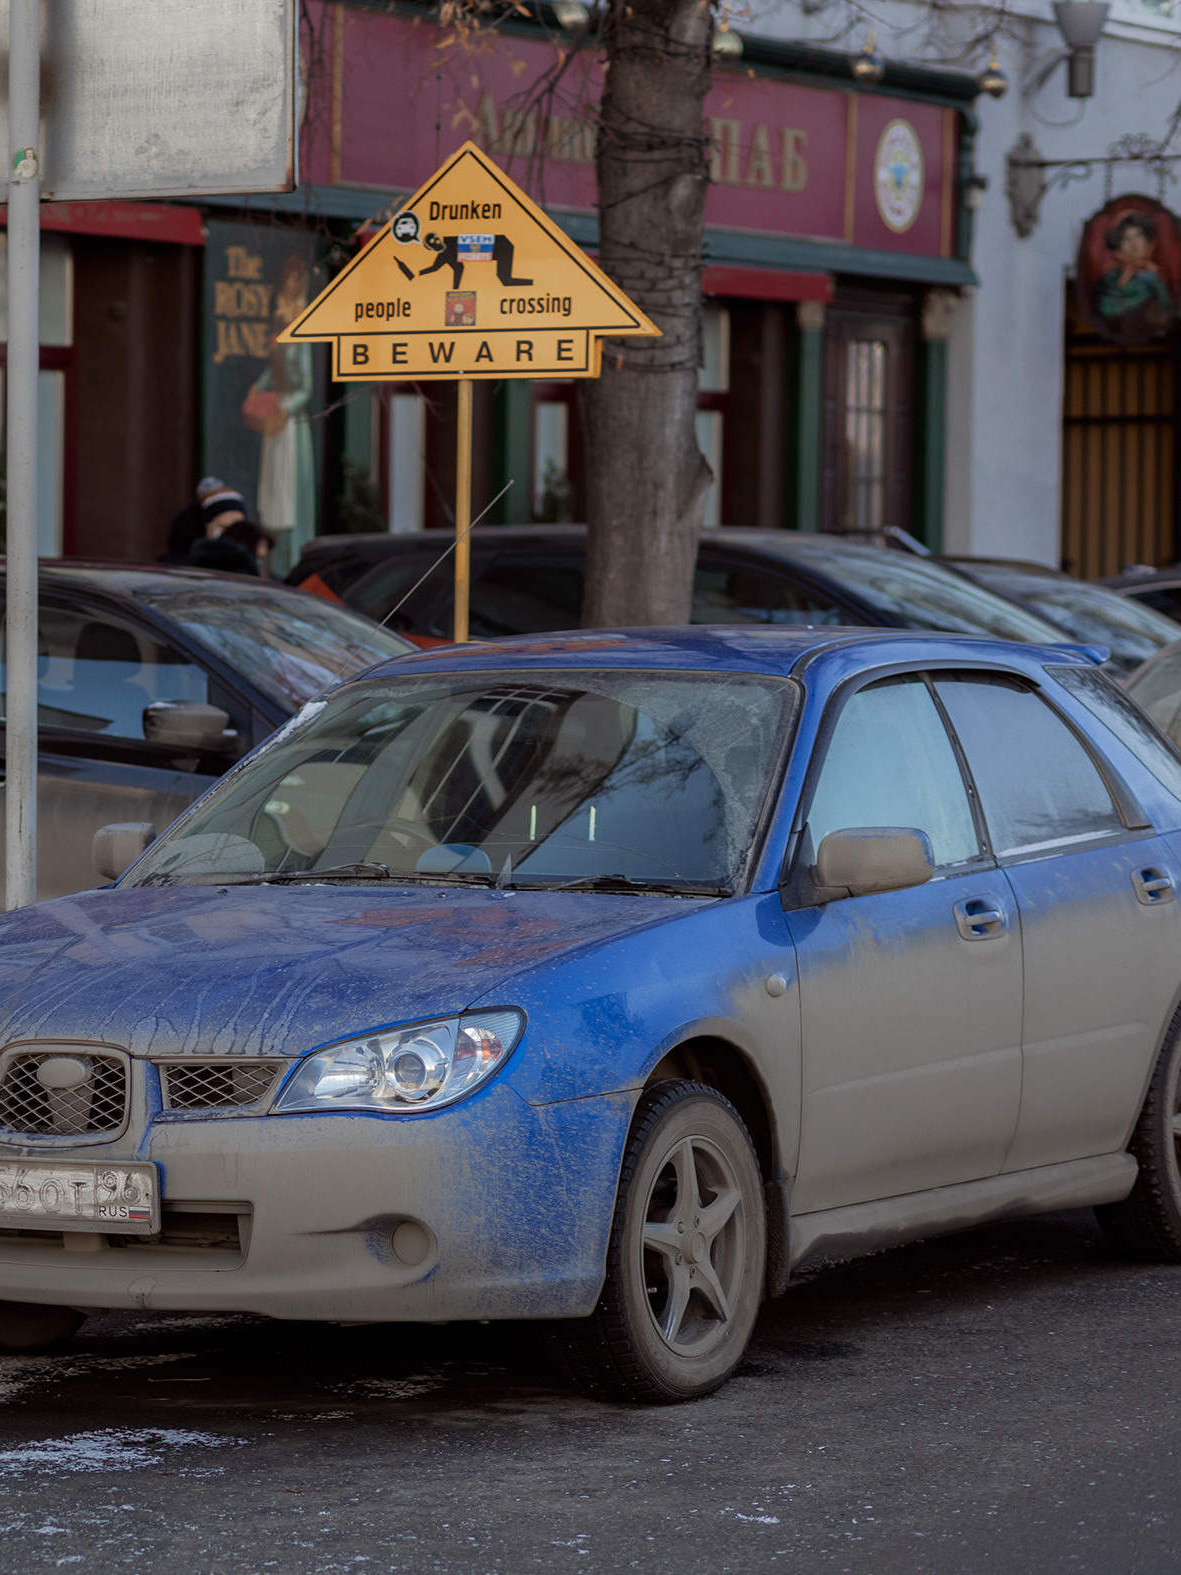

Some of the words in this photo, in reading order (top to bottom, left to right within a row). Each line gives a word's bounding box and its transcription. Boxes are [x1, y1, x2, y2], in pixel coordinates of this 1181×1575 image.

[708, 116, 808, 193] ПАБ
[429, 200, 502, 221] Drunken
[224, 246, 263, 278] The
[214, 281, 273, 317] ROSY
[354, 298, 412, 322] people
[500, 293, 572, 316] crossing
[212, 321, 269, 363] JANE
[352, 339, 574, 365] BEWARE
[98, 1205, 128, 1218] RUS
